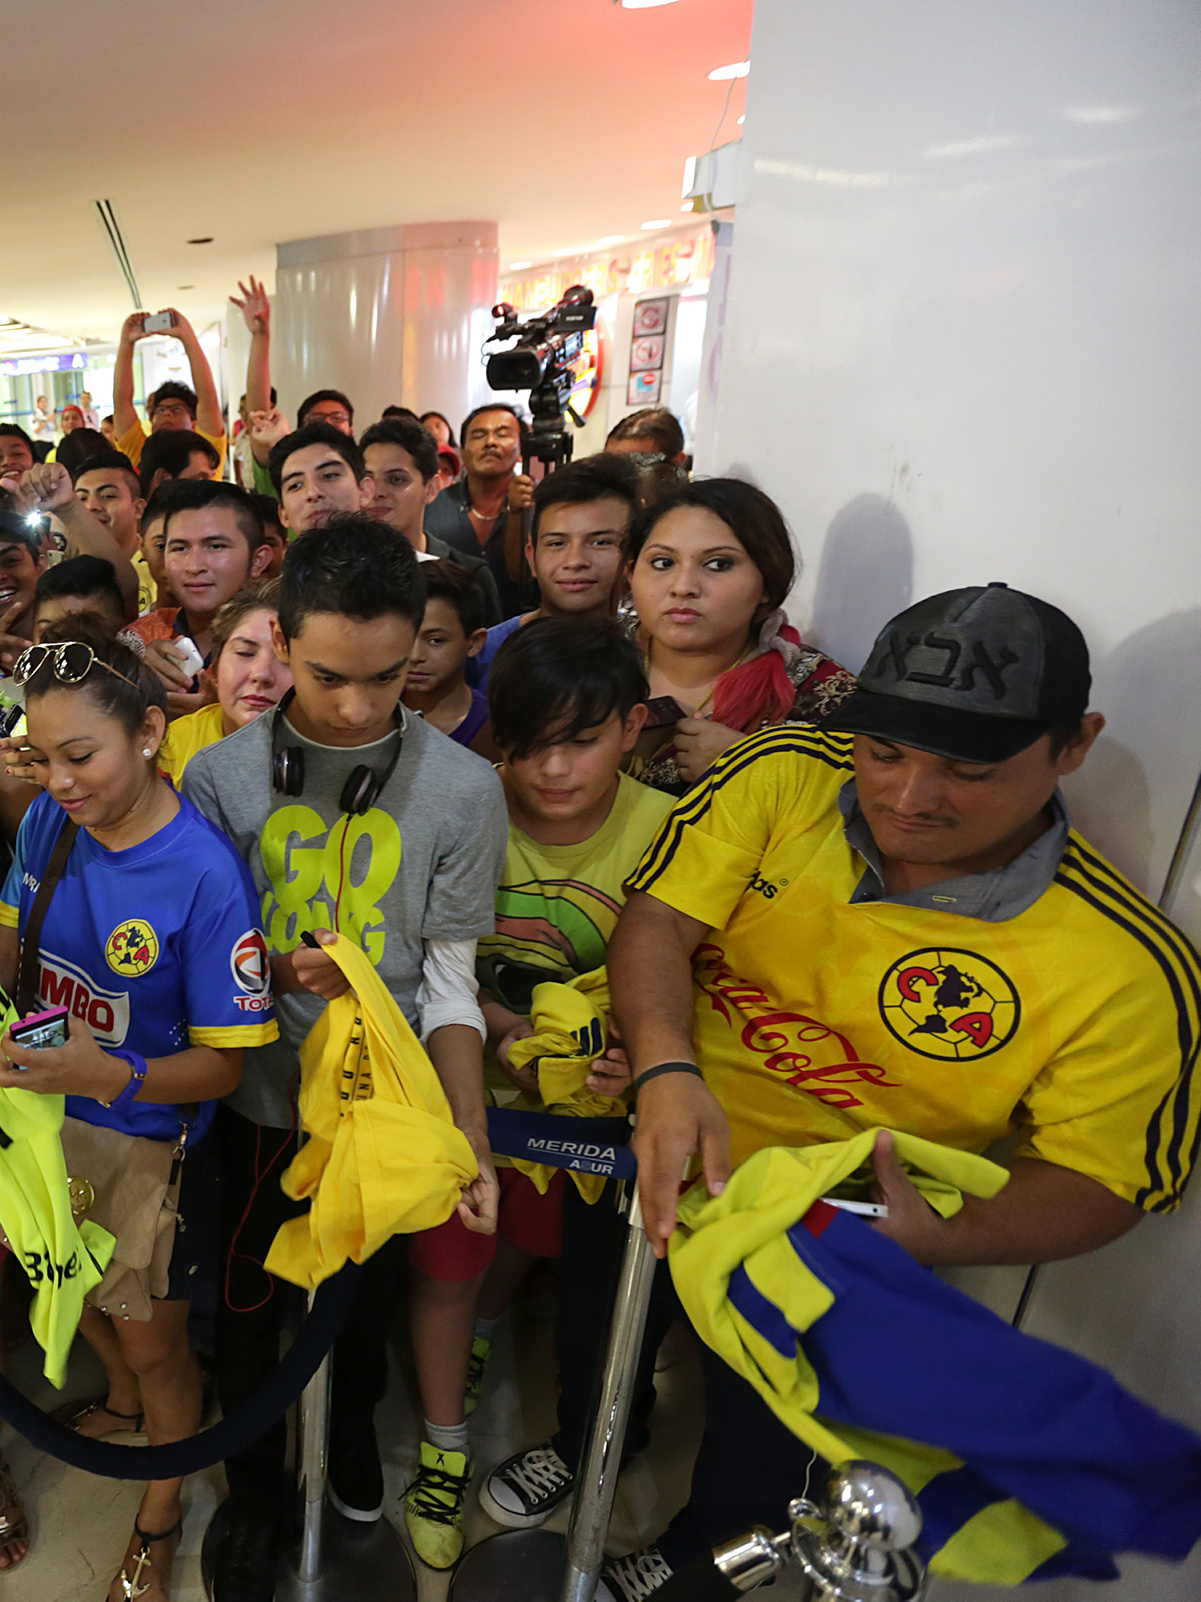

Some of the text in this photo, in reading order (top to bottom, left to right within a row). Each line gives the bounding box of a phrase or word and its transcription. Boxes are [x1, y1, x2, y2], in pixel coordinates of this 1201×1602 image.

[260, 804, 402, 908] GO
[38, 966, 115, 1033] MBO
[234, 994, 274, 1011] TOT
[527, 1138, 616, 1161] MERIDA
